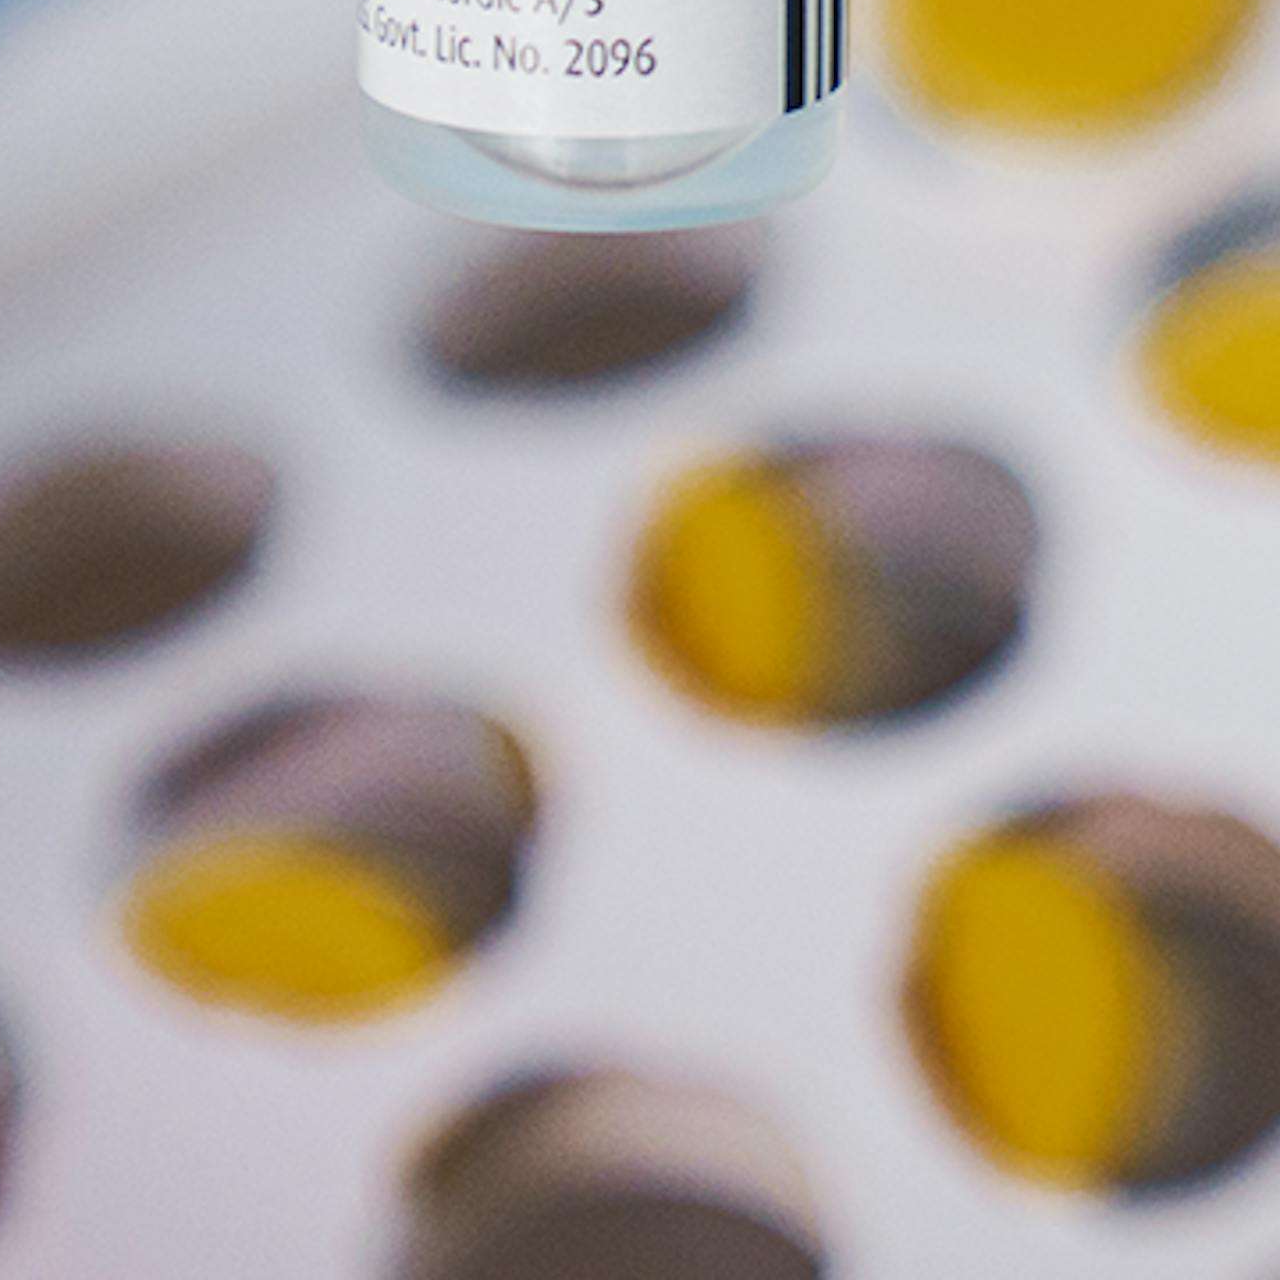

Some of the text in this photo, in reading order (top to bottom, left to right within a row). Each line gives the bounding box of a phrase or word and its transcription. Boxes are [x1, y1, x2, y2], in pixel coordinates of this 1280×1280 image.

[374, 4, 427, 58] Govt.
[435, 24, 481, 69] Lic.
[493, 34, 550, 76] No.
[564, 37, 657, 78] 2096
